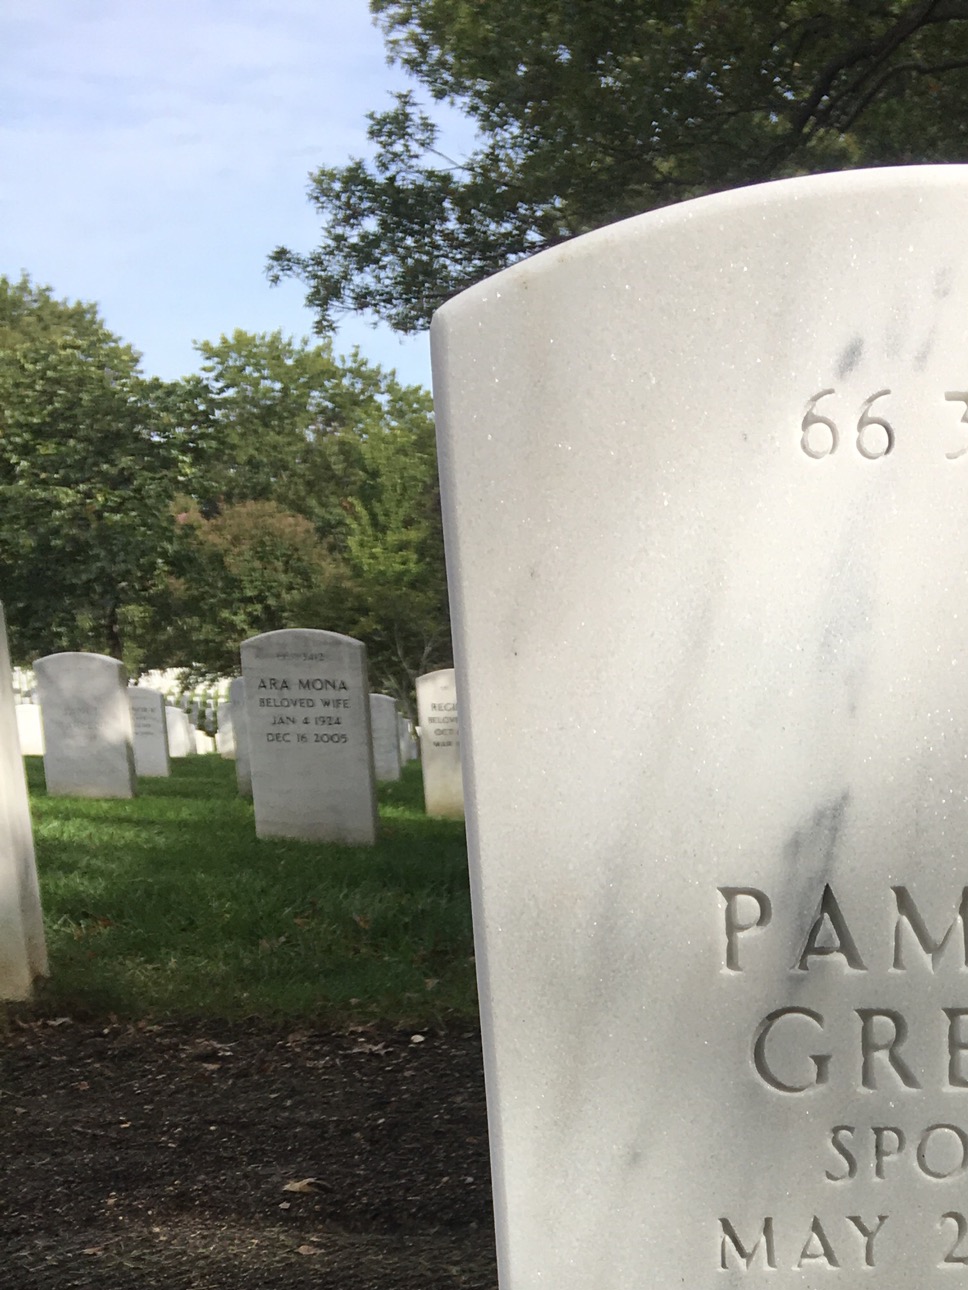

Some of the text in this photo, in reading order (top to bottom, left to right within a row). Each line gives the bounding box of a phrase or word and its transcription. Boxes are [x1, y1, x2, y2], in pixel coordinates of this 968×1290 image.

[800, 388, 895, 460] 66
[258, 678, 348, 691] ARA MONA
[259, 698, 350, 709] BELOVED WIFE
[271, 715, 296, 725] JAN
[315, 716, 342, 726] 1924
[266, 732, 291, 743] DEC
[313, 732, 349, 744] 2005
[716, 1214, 889, 1270] MAY
